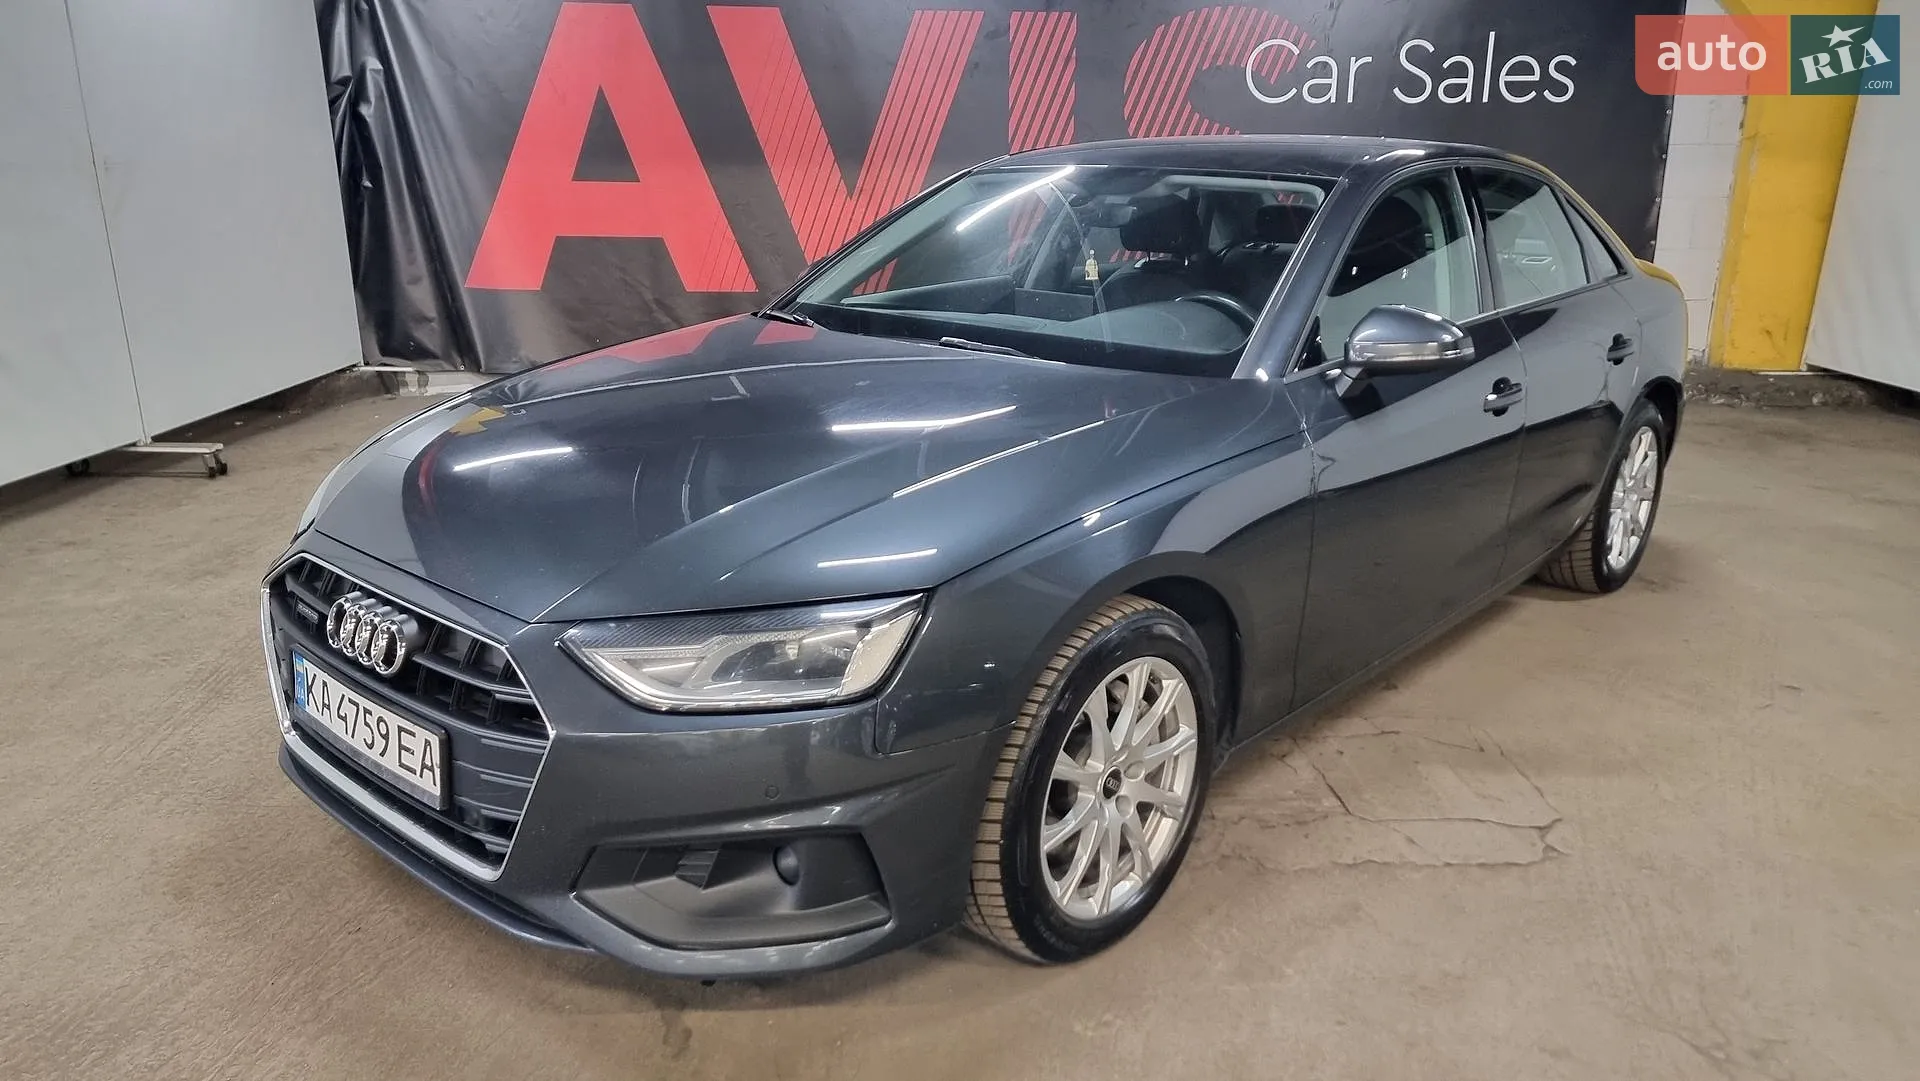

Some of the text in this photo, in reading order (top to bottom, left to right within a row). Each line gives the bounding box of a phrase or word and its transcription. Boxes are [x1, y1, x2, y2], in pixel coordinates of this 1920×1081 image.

[1246, 31, 1577, 104] Car Sales
[305, 666, 437, 787] KA 4759 EA
